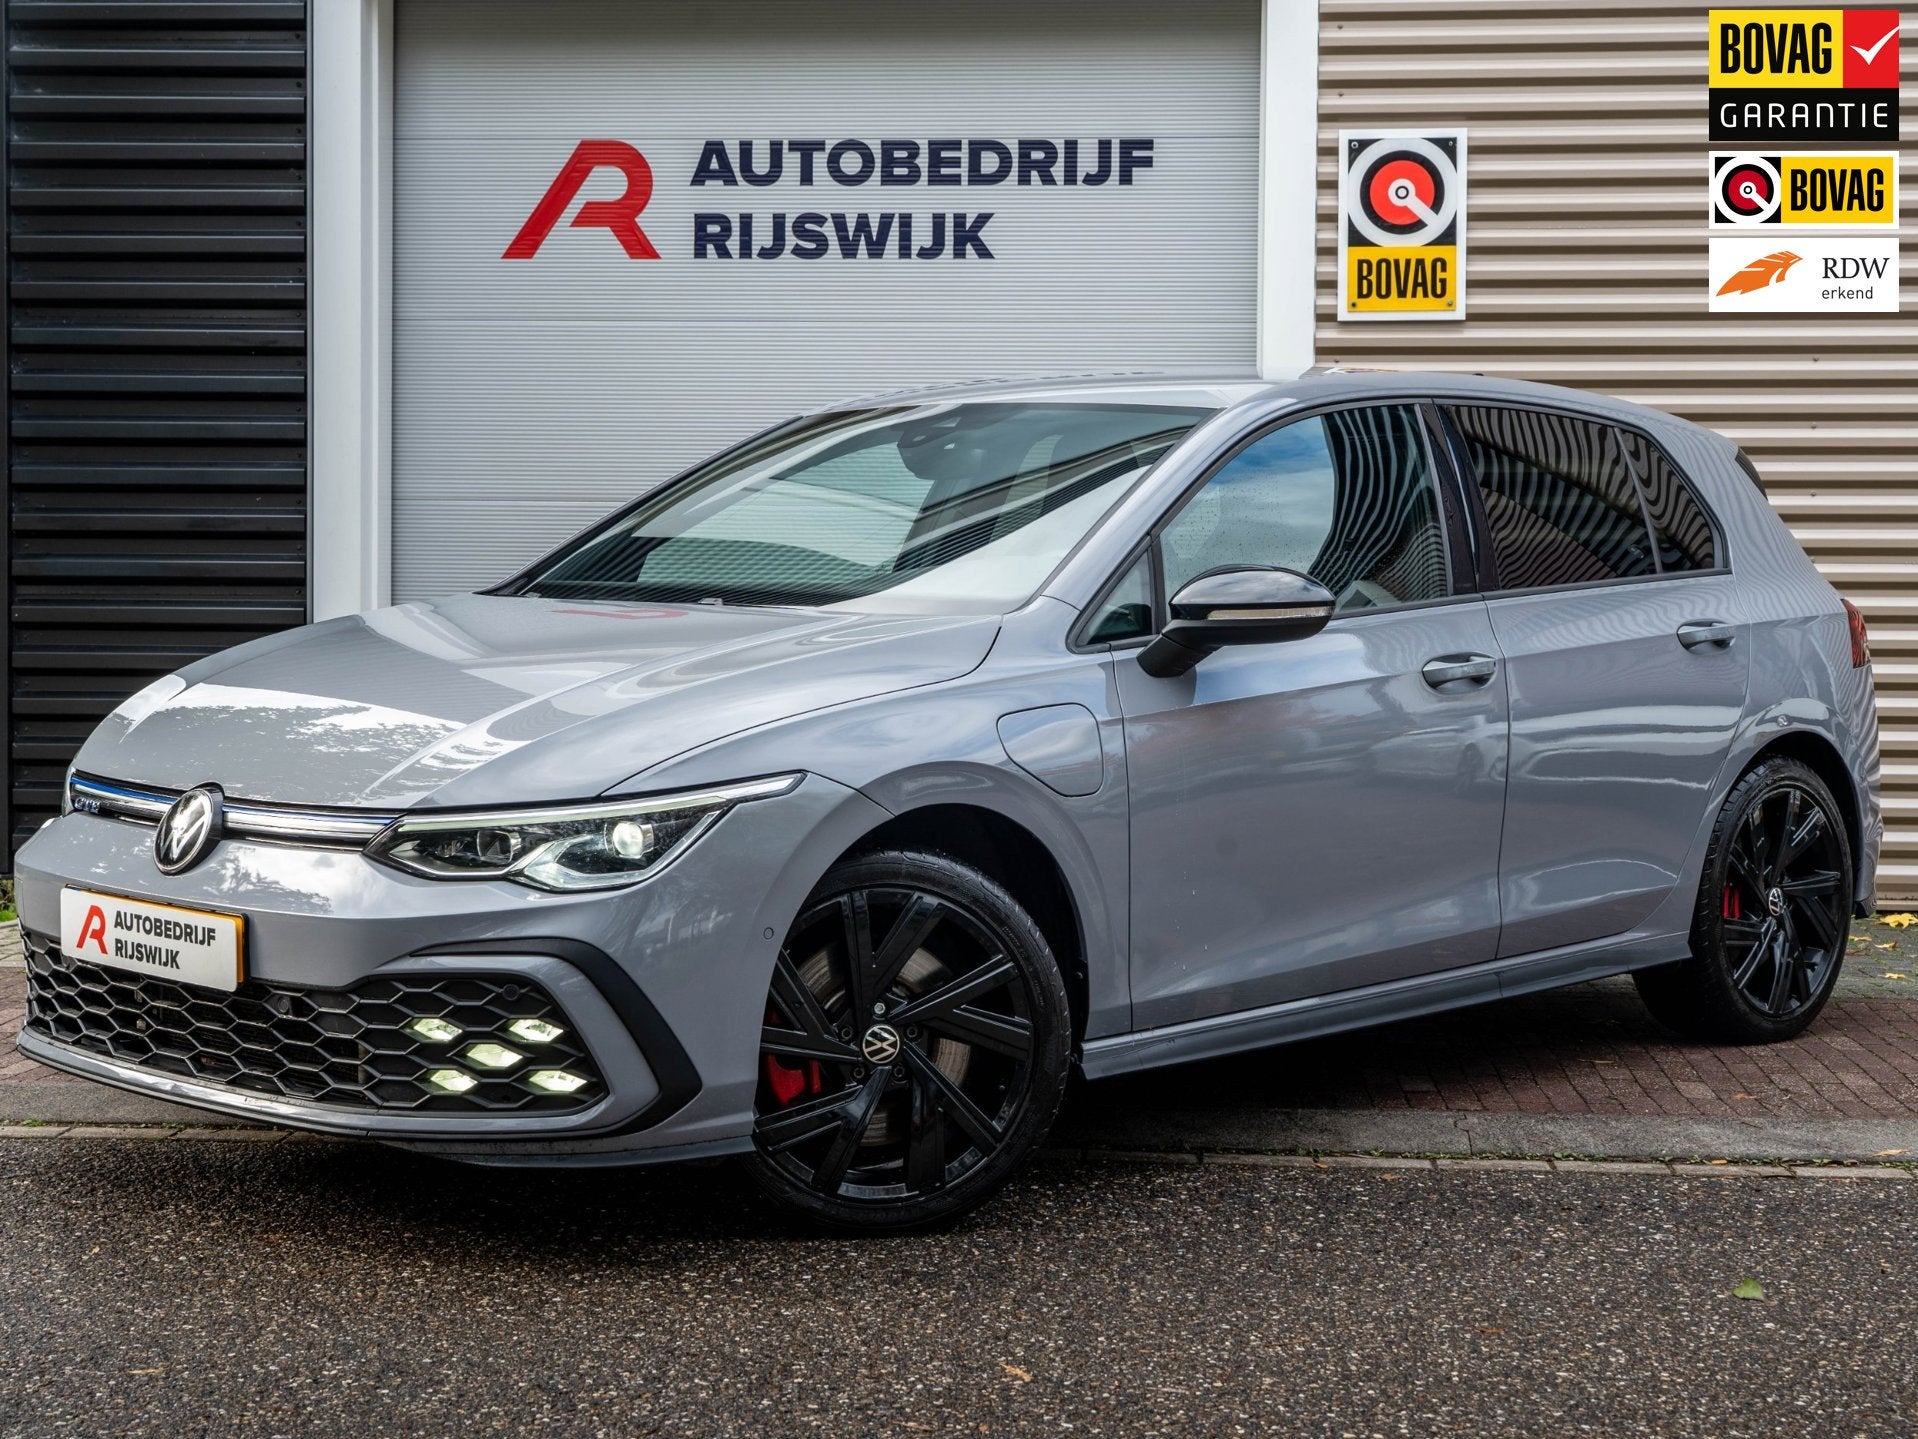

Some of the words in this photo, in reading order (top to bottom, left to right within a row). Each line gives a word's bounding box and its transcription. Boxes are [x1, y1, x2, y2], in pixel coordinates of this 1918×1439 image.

[690, 138, 1154, 187] AUTOBEDRIJF
[693, 212, 996, 260] RIJSWIJK
[1356, 256, 1448, 300] BOVAG
[113, 910, 216, 947] AUTOBEDRIJF
[114, 938, 180, 970] RIJSWIJK
